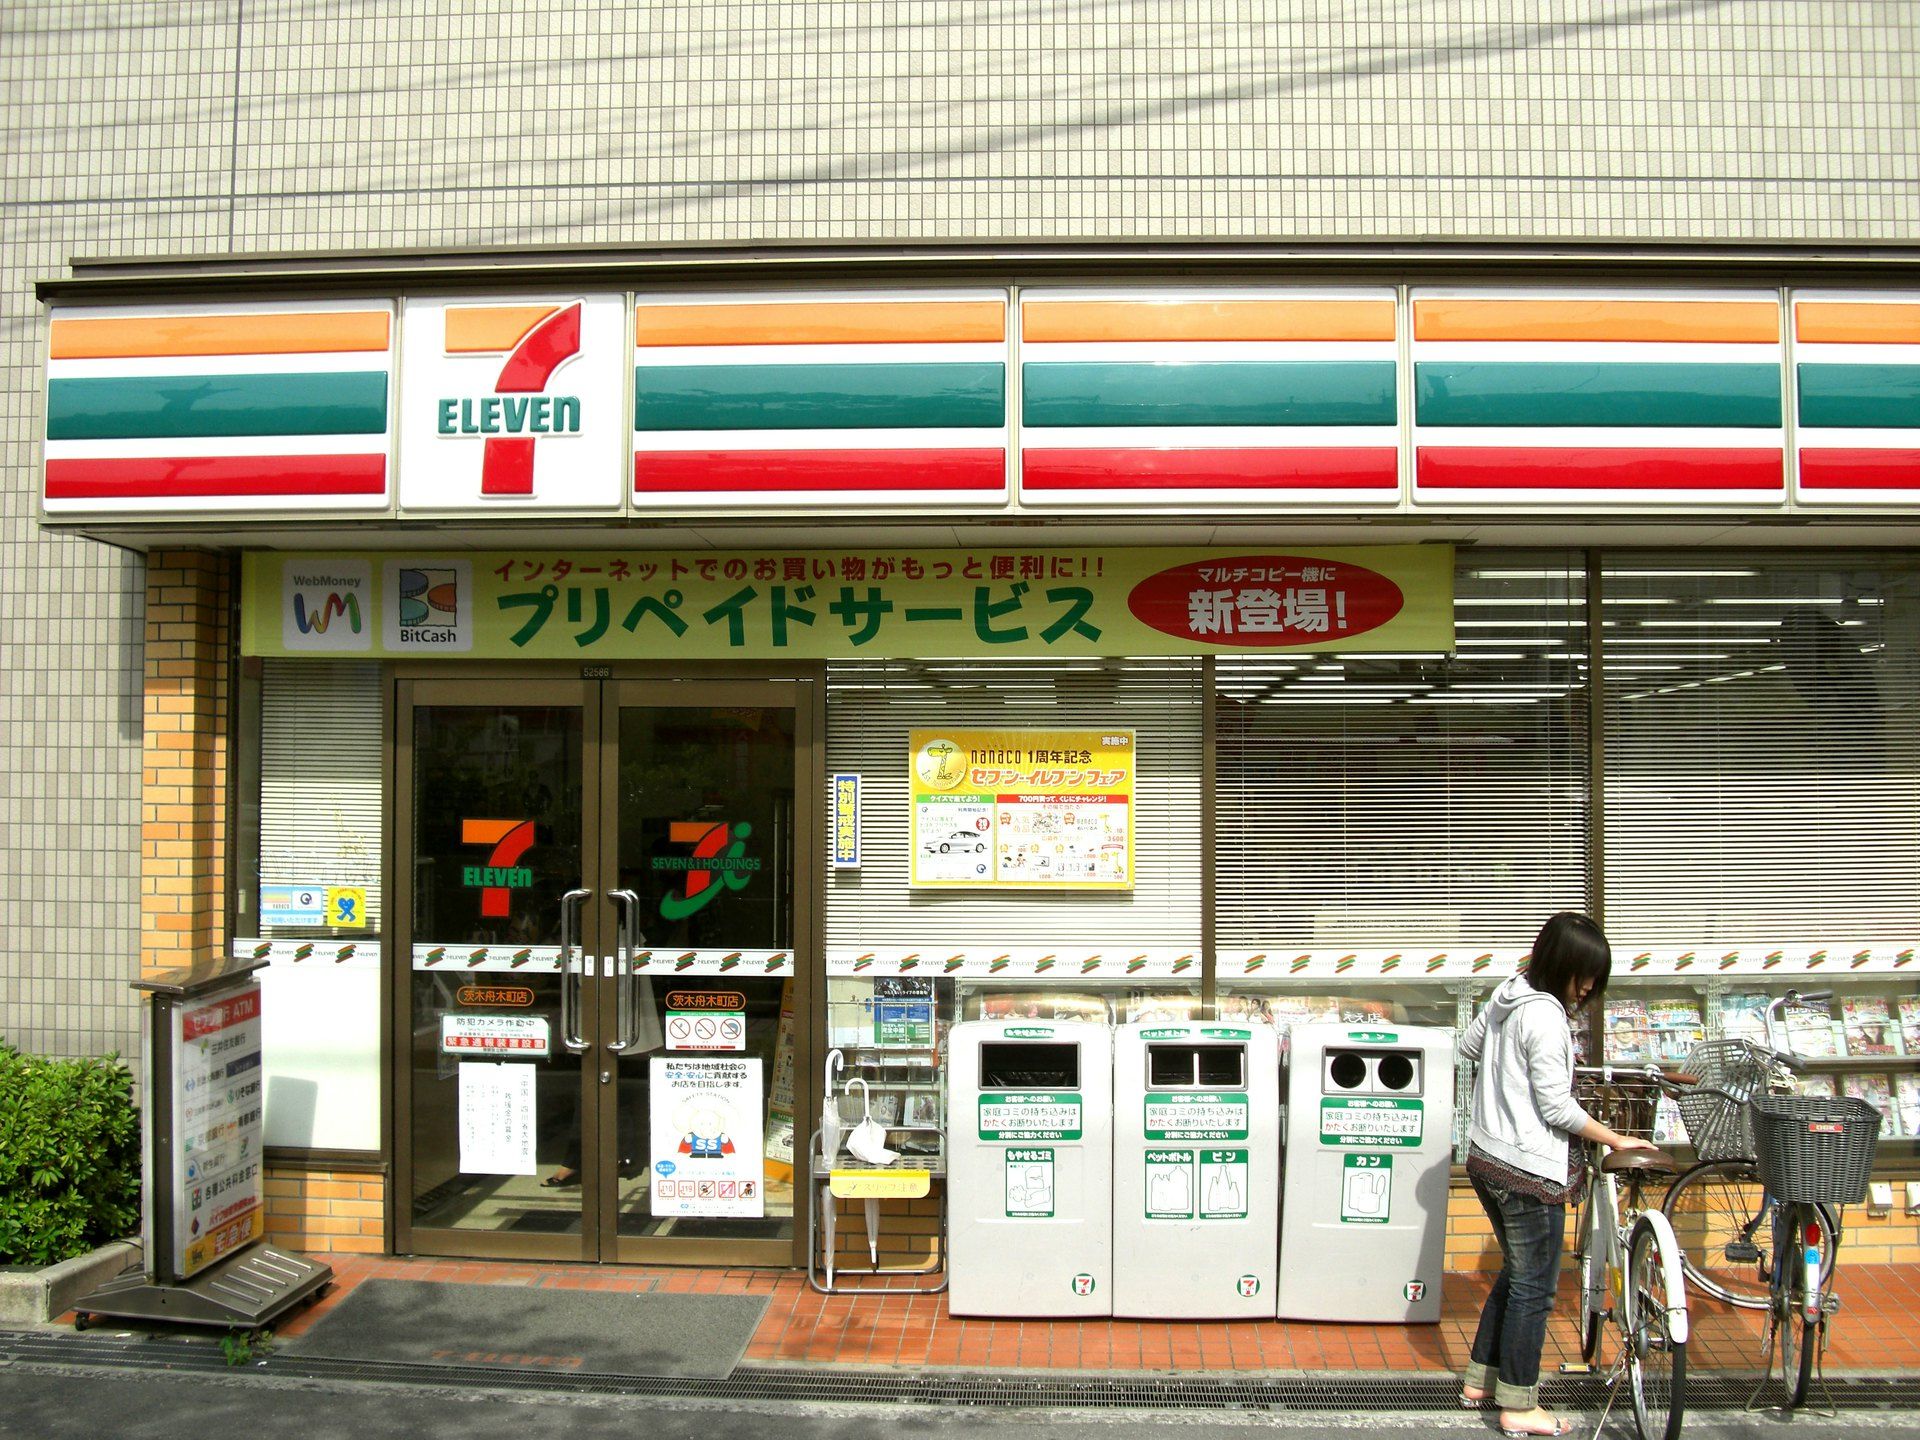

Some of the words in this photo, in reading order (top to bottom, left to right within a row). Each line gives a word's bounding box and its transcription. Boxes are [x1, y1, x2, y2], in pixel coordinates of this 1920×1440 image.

[445, 302, 580, 494] 7
[494, 556, 1104, 582] インターネットでのお買い物がもっと便利に!!
[1197, 566, 1336, 584] マルチコピー機に
[293, 575, 361, 589] WebMoney
[497, 583, 1102, 648] プリペイドサービス
[1188, 589, 1349, 634] 新登場!
[400, 629, 457, 643] BitCash
[584, 667, 609, 677] 52586
[1101, 736, 1129, 746] 実施中
[971, 749, 1021, 764] nanaco
[1028, 750, 1092, 764] 1周年記念
[704, 857, 761, 870] HOLDINGS
[463, 990, 527, 1003] 茨木舟木町店
[672, 995, 739, 1007] 茨木舟木町店
[233, 998, 253, 1016] ATM
[456, 1017, 535, 1027] 防犯カメラ作動中
[666, 1062, 746, 1071] 私たちは地域社会の
[665, 1072, 748, 1080] 安全・安心に貢献する
[983, 1118, 1074, 1127] かたくお断りいたします
[1149, 1118, 1241, 1128] かたくお断りいたします
[1325, 1122, 1416, 1132] かたくお断りいたします
[695, 1139, 718, 1150] SS
[1007, 1150, 1052, 1161] もやせるゴミ
[1147, 1152, 1192, 1162] ペットボトル
[1212, 1152, 1236, 1162] ビン
[1356, 1156, 1380, 1167] カン
